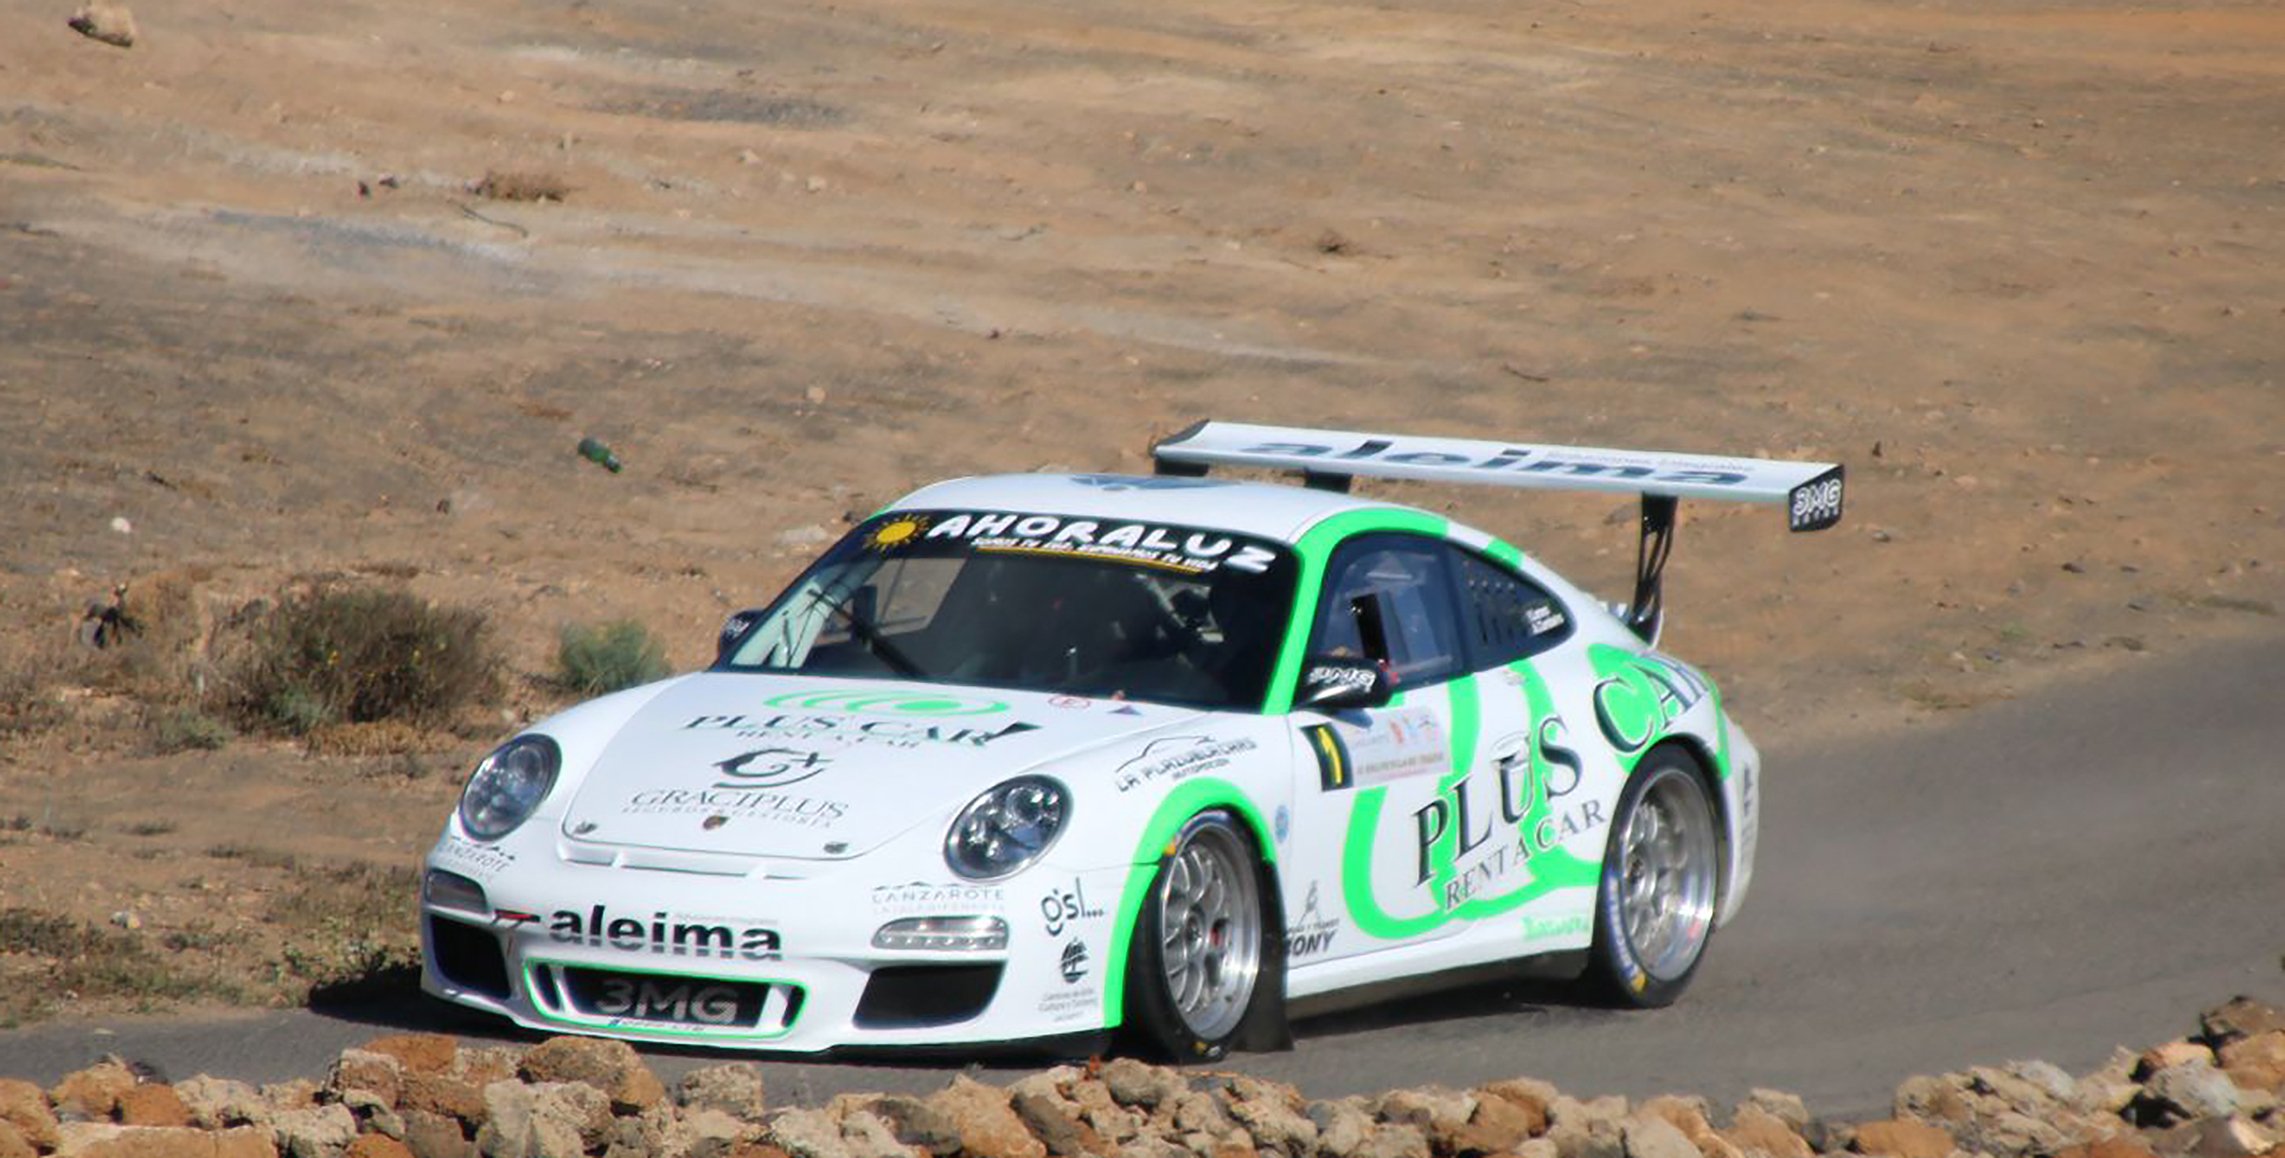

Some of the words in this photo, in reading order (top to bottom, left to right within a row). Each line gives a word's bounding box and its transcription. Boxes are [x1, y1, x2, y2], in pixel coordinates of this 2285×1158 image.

[1241, 439, 1752, 485] aleima
[1793, 478, 1842, 516] 3MG
[925, 514, 1277, 573] AHORALUZ
[680, 714, 838, 730] PLUS
[1316, 726, 1343, 785] 1
[631, 788, 849, 818] GRACIPLUS
[1412, 715, 1584, 888] PLUS
[1445, 848, 1508, 910] RENT
[1512, 834, 1531, 860] A
[1535, 798, 1607, 851] CAR
[872, 888, 1004, 904] LANZAROTE
[550, 904, 781, 952] aleima
[596, 979, 739, 1024] 3MG
